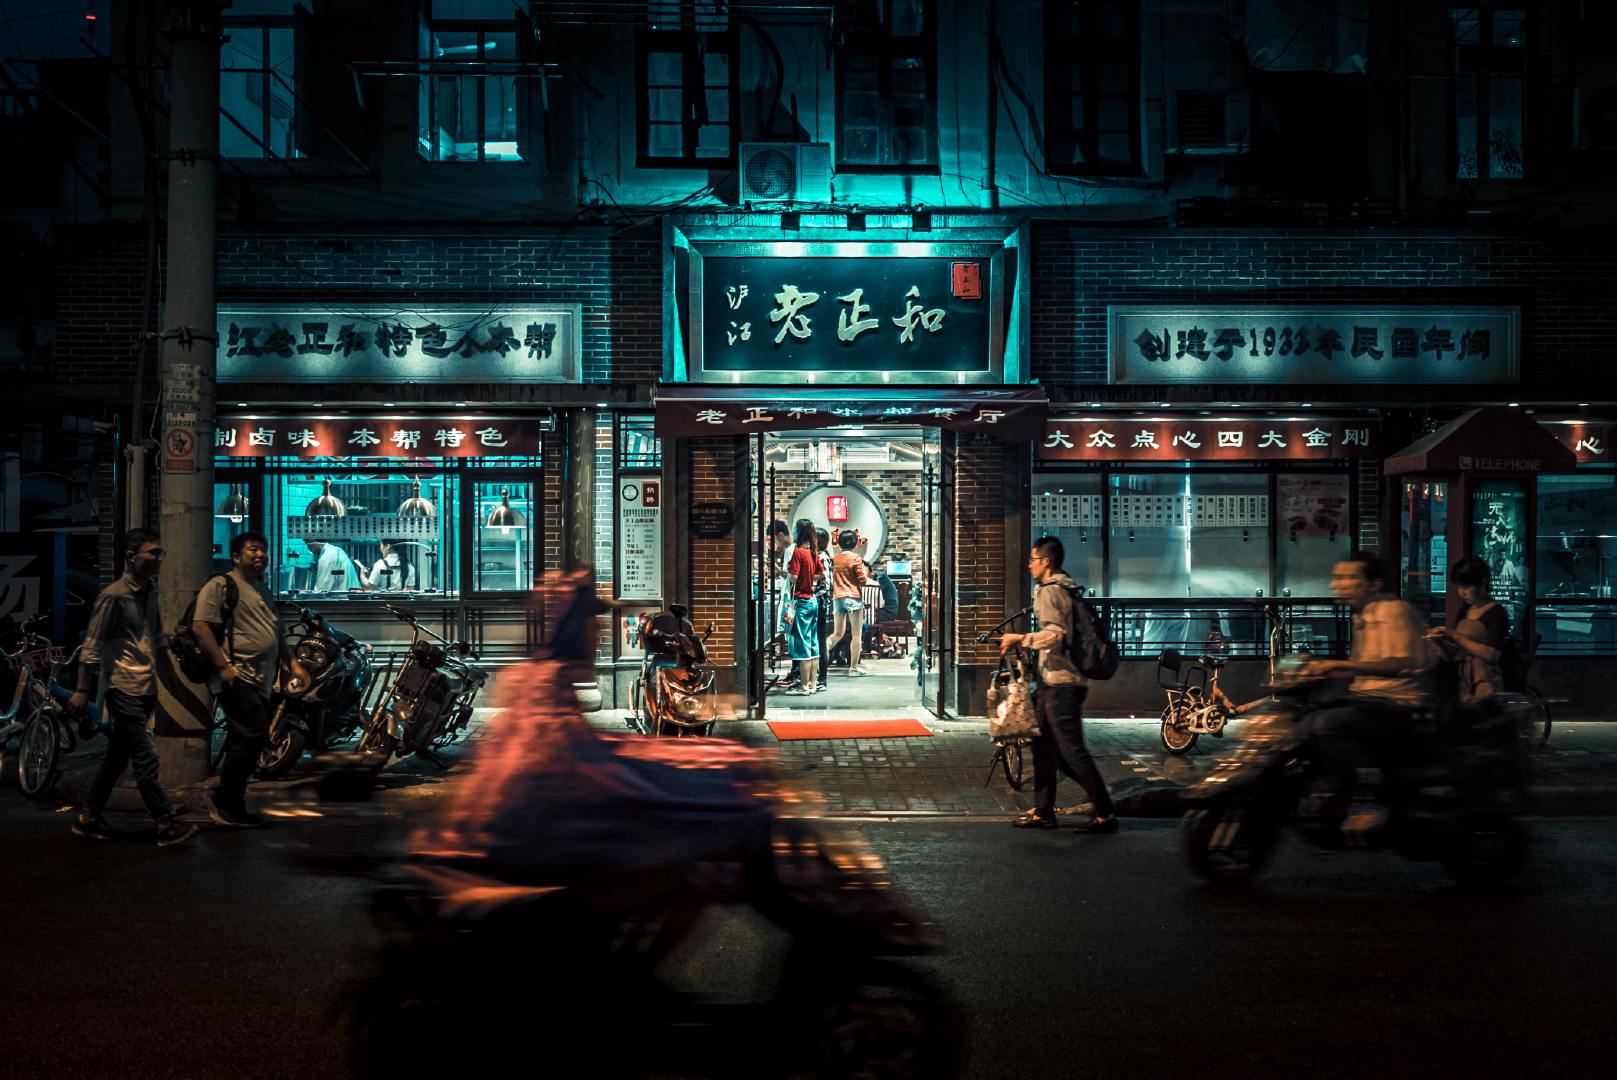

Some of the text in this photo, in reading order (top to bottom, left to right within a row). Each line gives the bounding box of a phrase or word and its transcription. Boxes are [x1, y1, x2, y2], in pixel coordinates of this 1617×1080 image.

[727, 285, 751, 346] 沪江
[770, 284, 947, 345] 老正和
[216, 321, 557, 360] 江老正和特色小本帮
[347, 427, 509, 449] 本帮特色
[1043, 427, 1371, 449] 大众点心四大金刚
[1474, 457, 1542, 472] TELEPHONE
